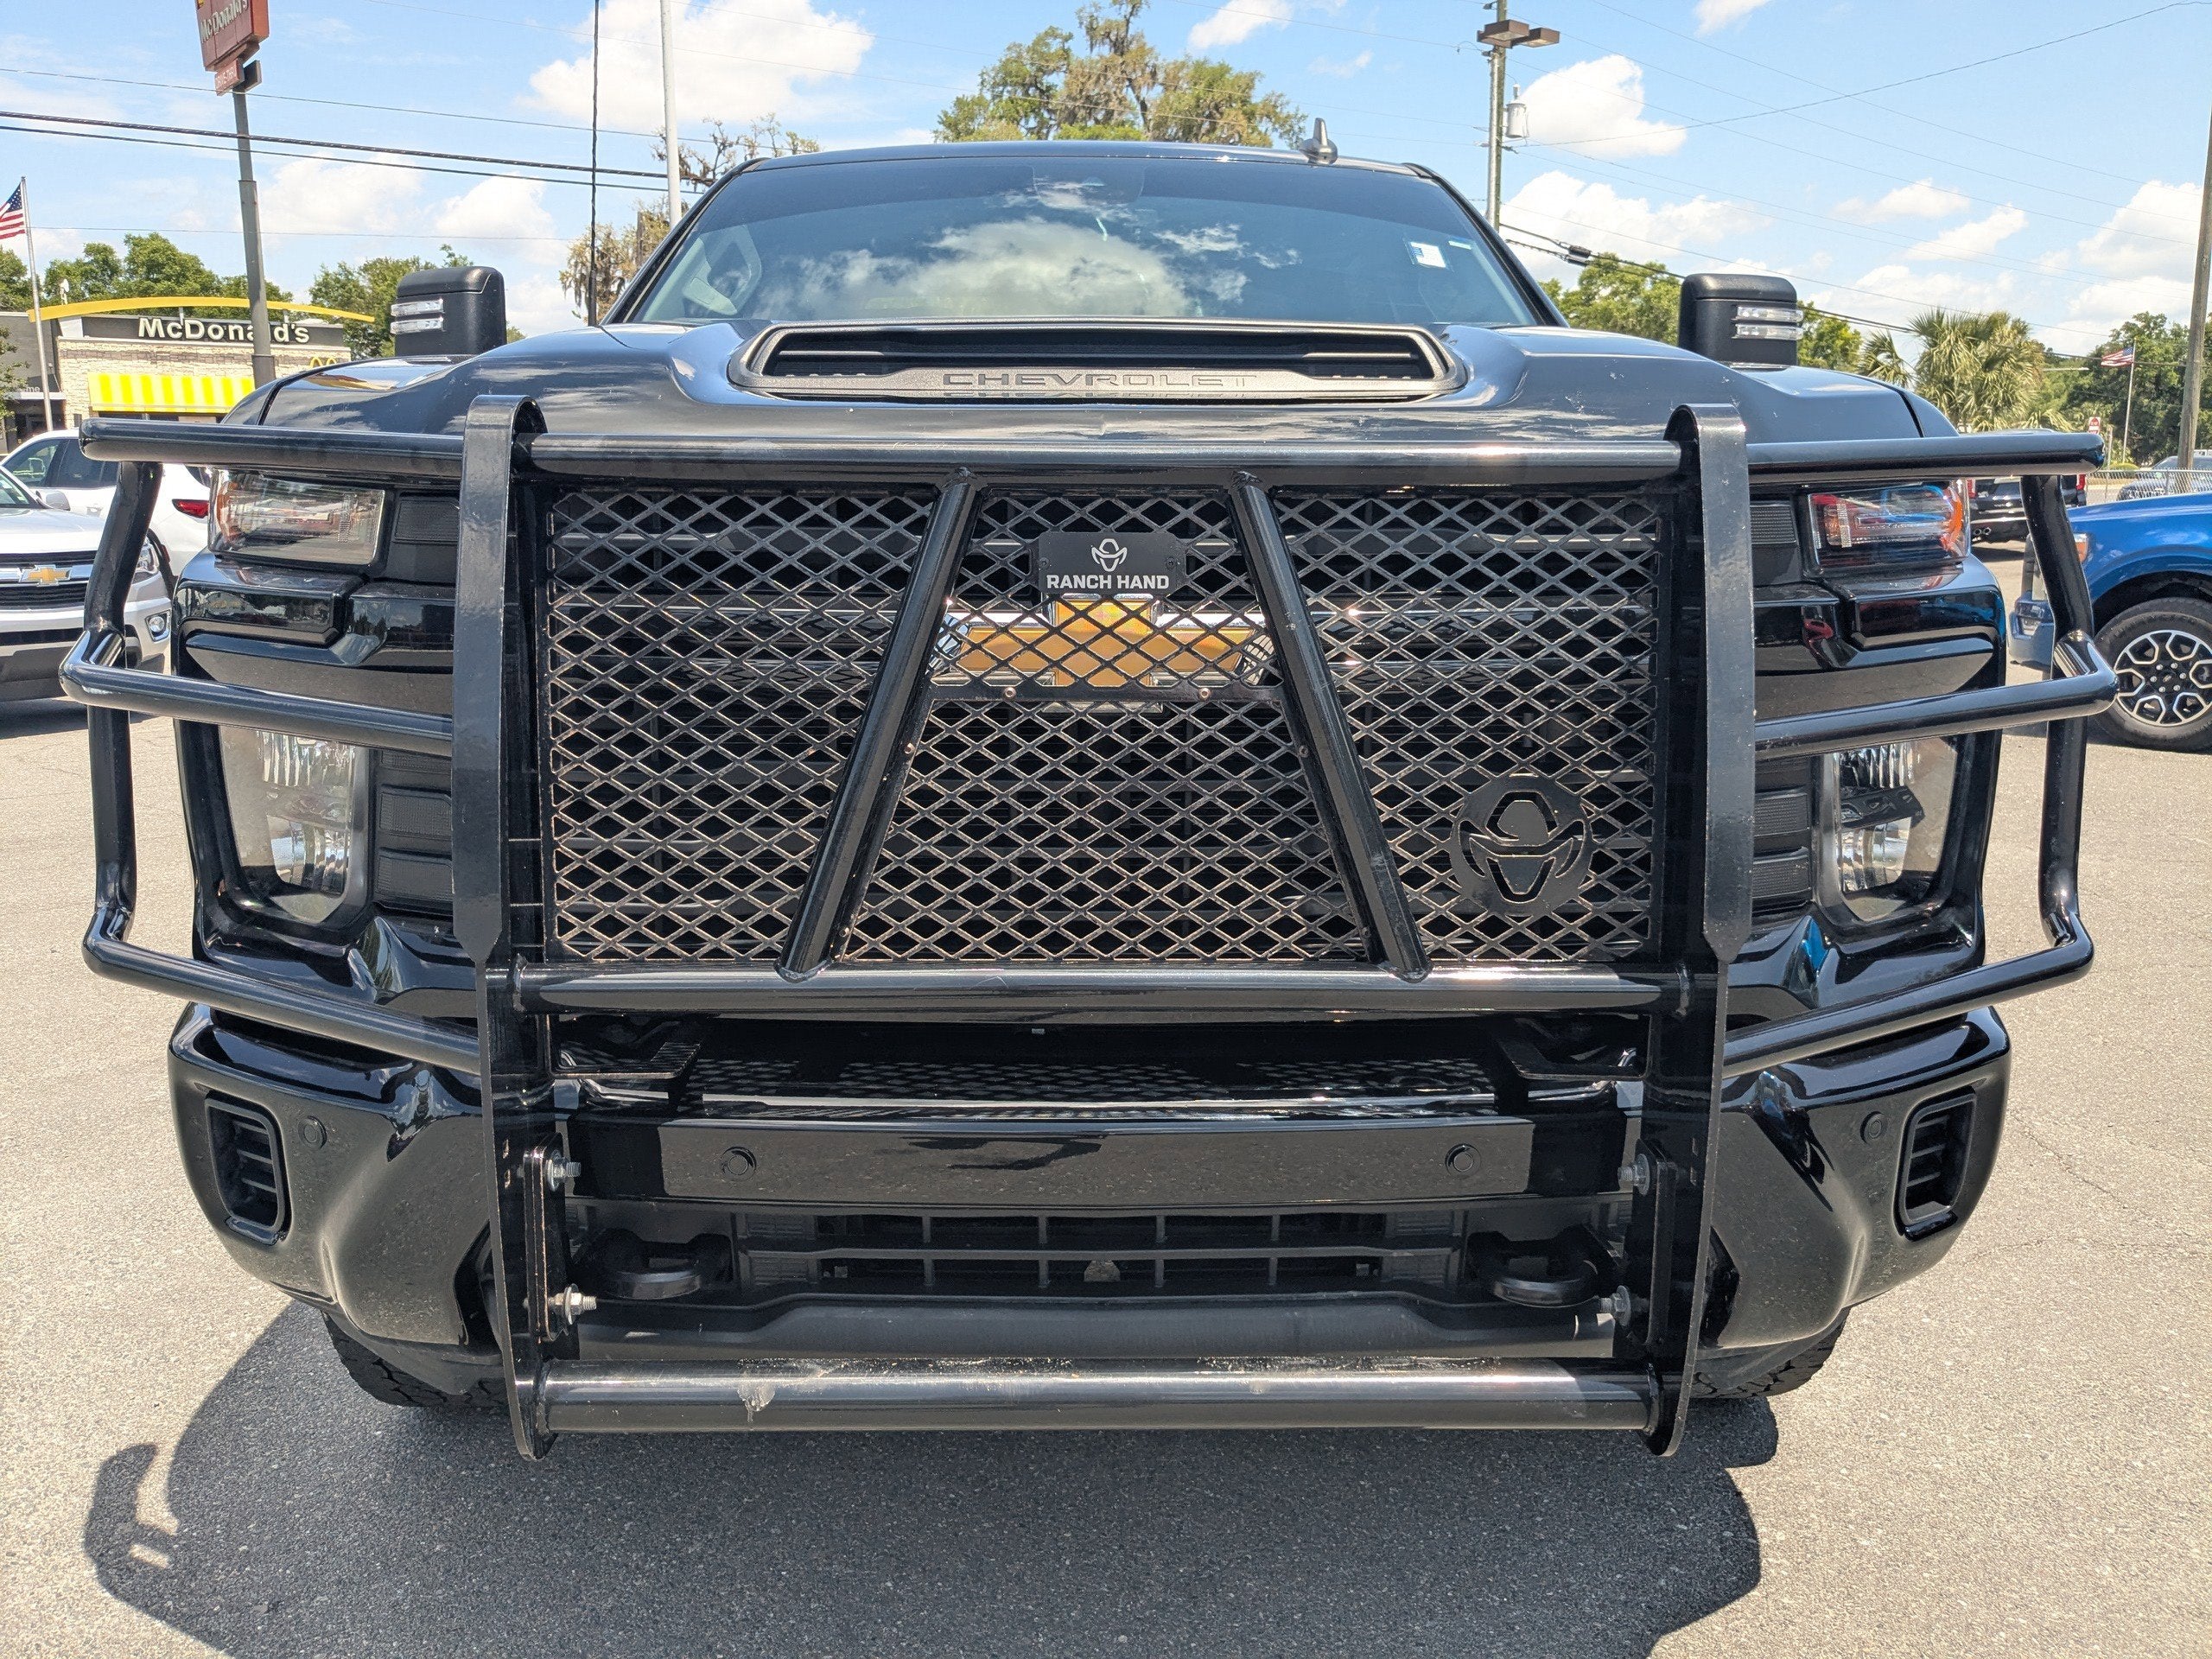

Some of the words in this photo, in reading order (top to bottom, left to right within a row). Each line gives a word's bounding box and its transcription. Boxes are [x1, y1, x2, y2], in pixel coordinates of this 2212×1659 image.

[138, 317, 309, 343] McDonad's
[943, 373, 1256, 386] CHEVROLET
[1046, 575, 1111, 589] RANCH
[1117, 575, 1169, 589] HAND
